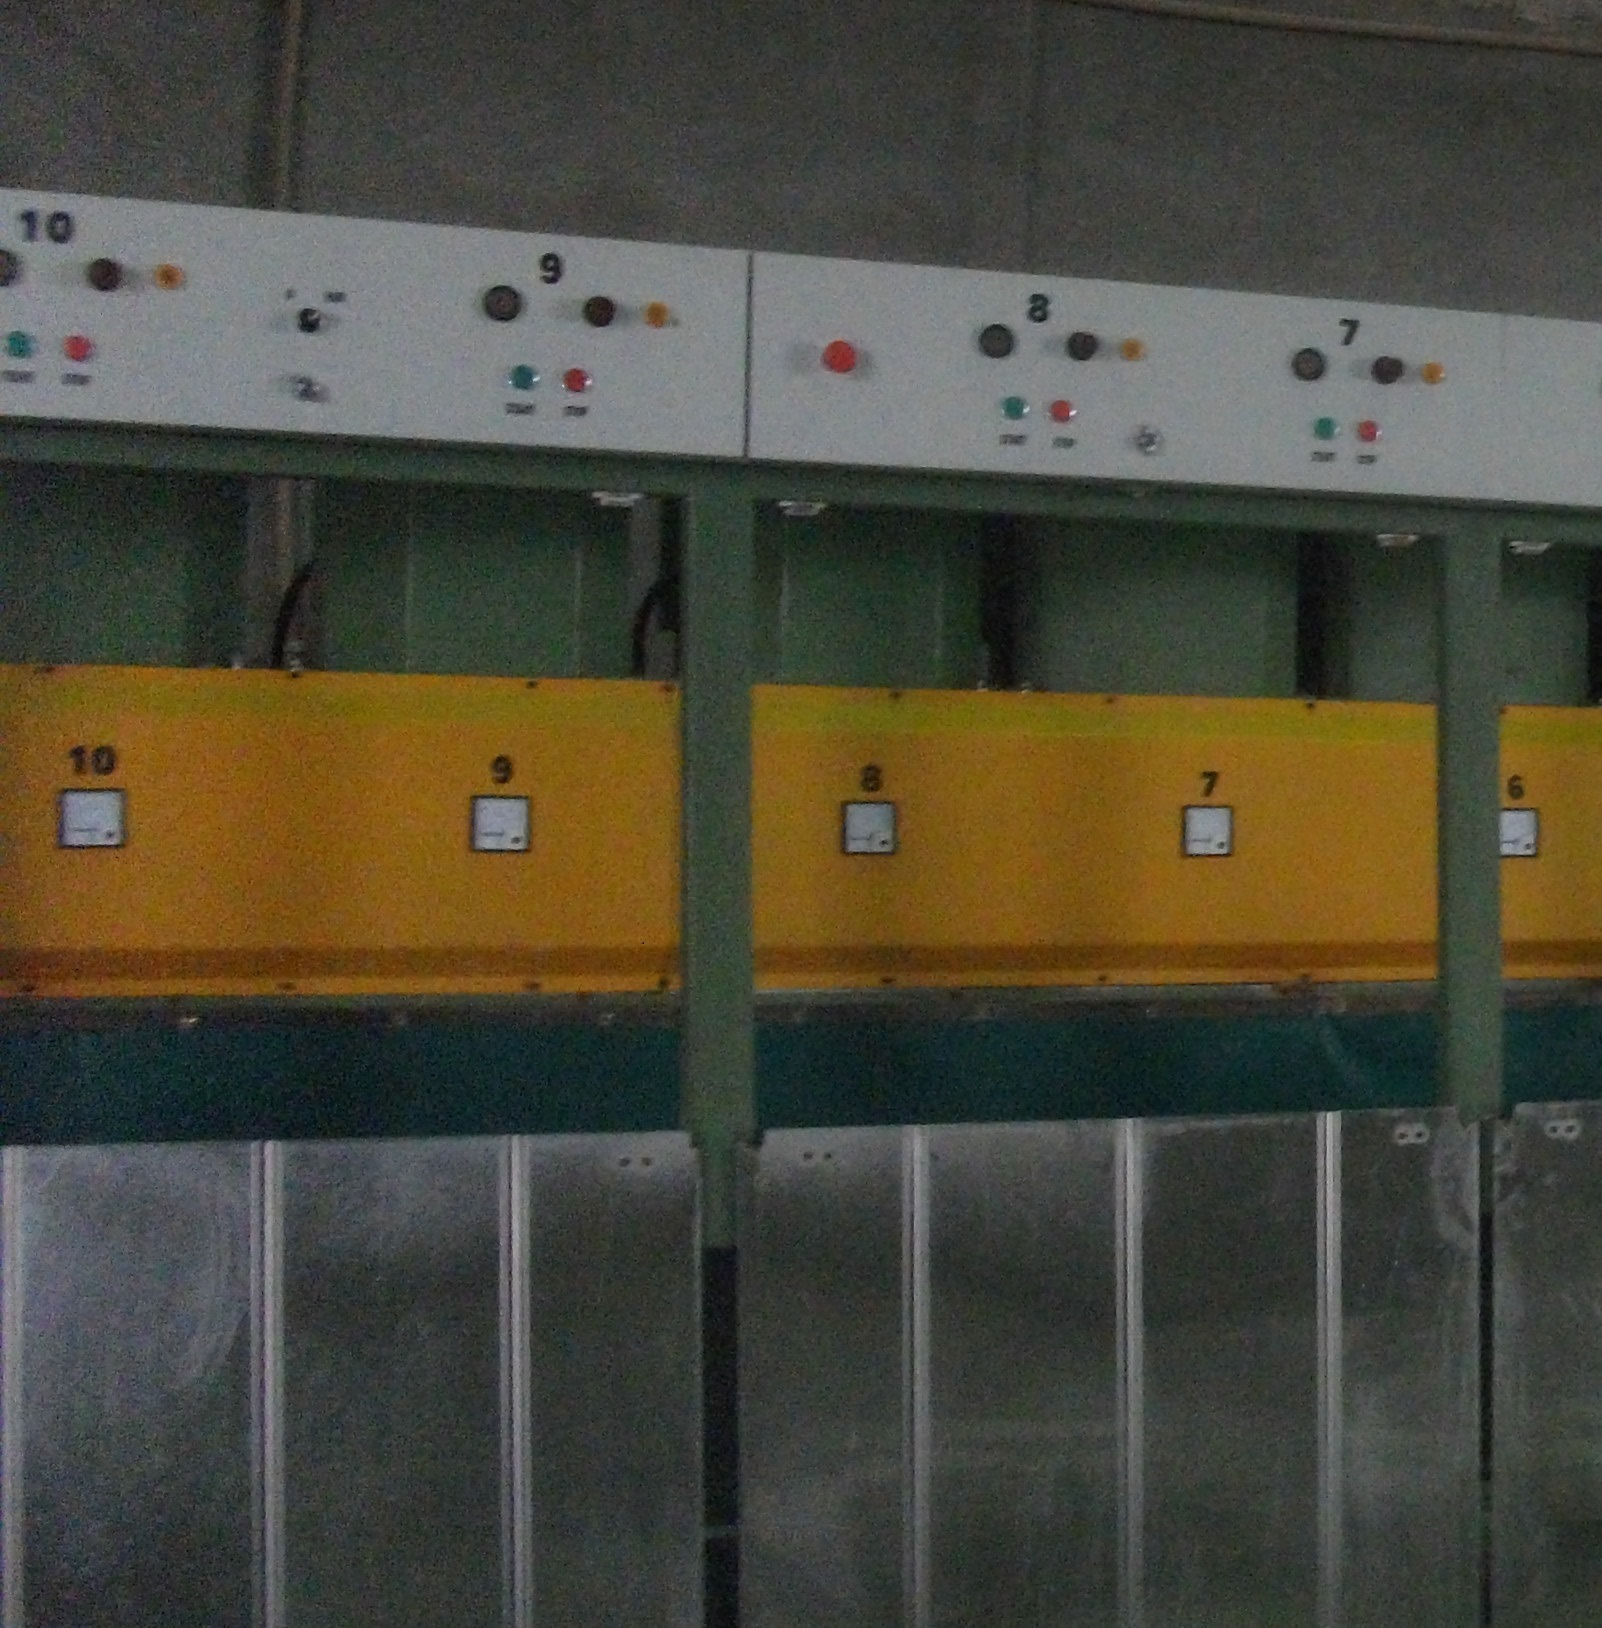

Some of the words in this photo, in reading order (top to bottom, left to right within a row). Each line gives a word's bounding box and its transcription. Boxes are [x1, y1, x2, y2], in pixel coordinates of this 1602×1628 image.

[20, 209, 75, 244] 10
[539, 252, 564, 284] 9
[1028, 293, 1050, 323] 8
[1339, 318, 1360, 346] 7
[69, 745, 117, 775] 10
[490, 754, 512, 784] 9
[861, 765, 883, 792] 8
[1201, 771, 1218, 797] 7
[1507, 774, 1524, 799] 6
